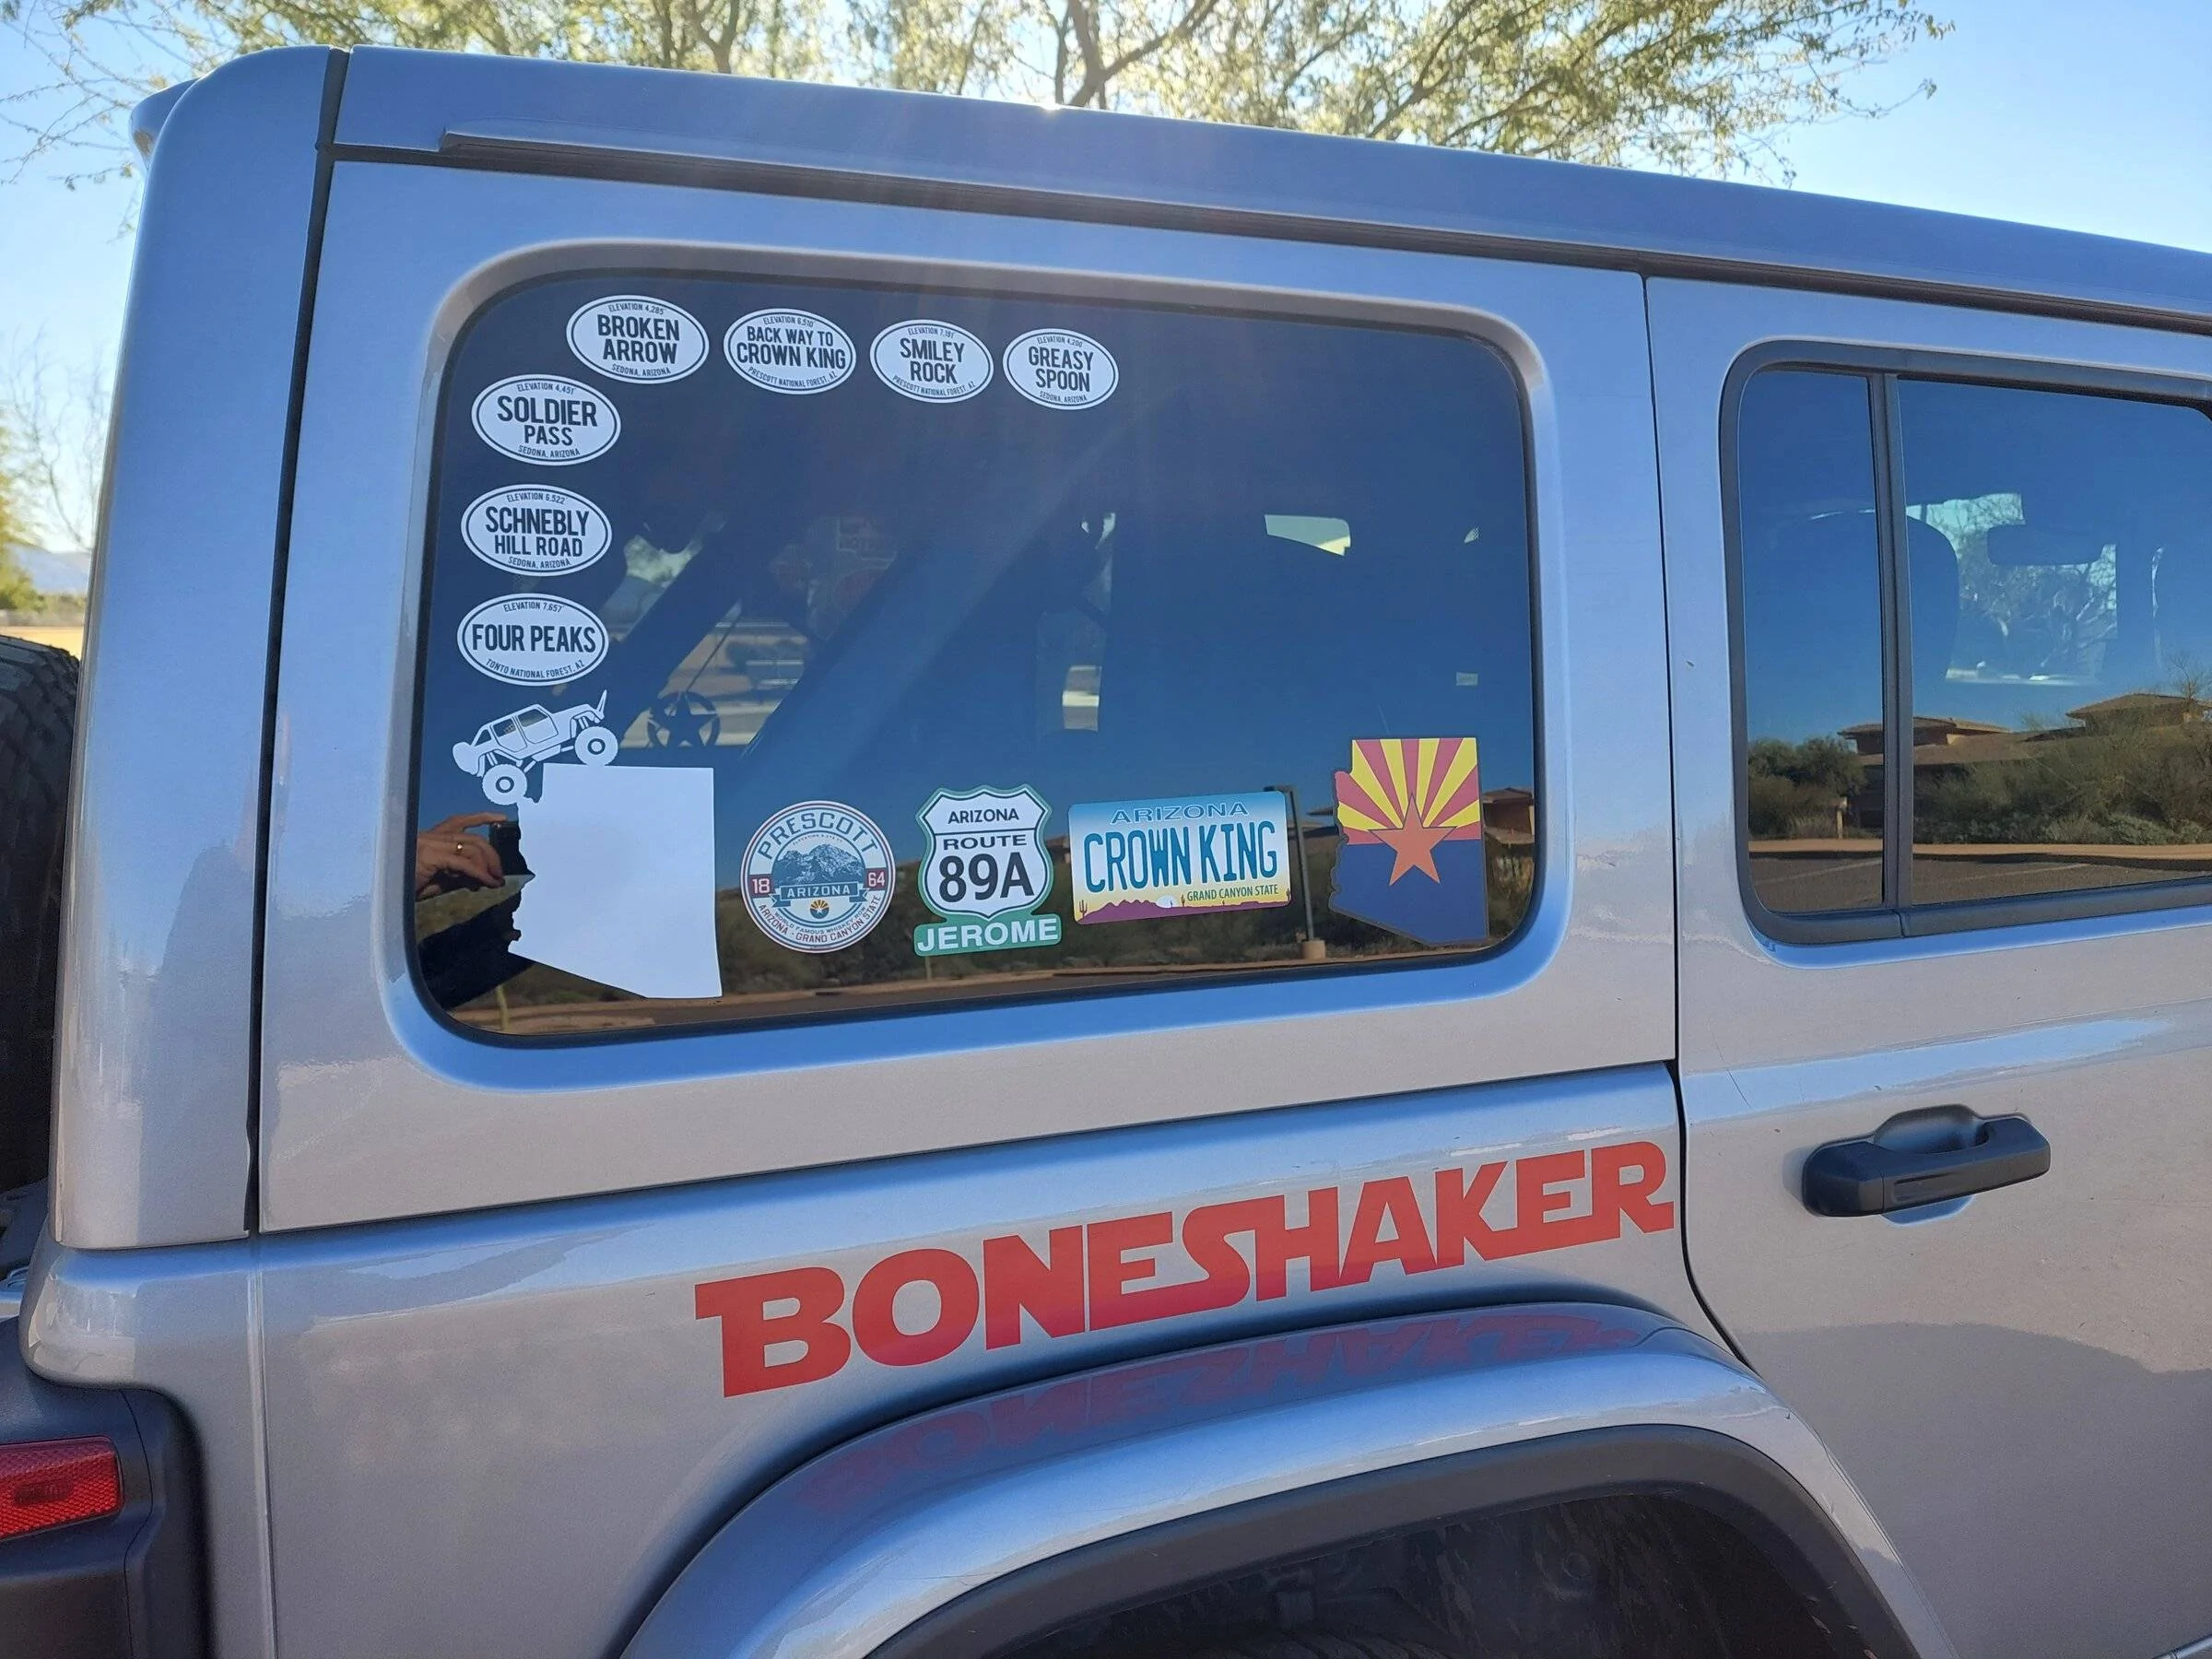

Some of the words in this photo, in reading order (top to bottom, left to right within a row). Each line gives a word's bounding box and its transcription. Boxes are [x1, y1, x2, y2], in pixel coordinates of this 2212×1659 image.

[608, 303, 643, 312] ELEVATION
[597, 314, 680, 341] BROKEN
[747, 326, 782, 343] BACK
[785, 328, 814, 345] WAY
[818, 332, 833, 347] TO
[900, 337, 964, 362] SMILEY
[1037, 335, 1065, 345] ELEVATION
[603, 339, 677, 364] ARROW
[737, 343, 801, 367] CROWN
[807, 347, 846, 369] KING
[1029, 347, 1093, 371] GREASY
[641, 367, 671, 376] ARIZONA
[748, 367, 778, 384] PRESCOTT
[779, 378, 806, 387] NATIONAL
[830, 371, 837, 380] AZ
[911, 361, 958, 383] ROCK
[1036, 369, 1089, 392] SPOON
[517, 382, 553, 393] ELEVATION
[892, 375, 920, 393] PRESCOTT
[920, 387, 946, 395] NATIONAL
[1064, 394, 1087, 404] ARIZONA
[498, 395, 597, 427] SOLDIER
[524, 424, 573, 446] PASS
[549, 448, 581, 458] ARIZONA
[507, 493, 544, 502] ELEVATION
[485, 507, 589, 536] SCHNEBLY
[494, 535, 531, 555] HILL
[536, 536, 582, 557] ROAD
[540, 559, 571, 569] ARIZONA
[503, 601, 540, 612] ELEVATION
[472, 624, 525, 651] FOUR
[531, 625, 595, 653] PEAKS
[486, 658, 509, 674] TONTO
[510, 667, 546, 678] NATIONAL
[575, 660, 584, 671] AZ
[947, 807, 1019, 824] ARIZONA
[1110, 802, 1249, 825] ARIZONA
[758, 813, 878, 859] PRESCOTT
[943, 834, 1028, 851] ROUTE
[1084, 827, 1191, 892] CROWN
[1199, 820, 1277, 885] KING
[752, 877, 771, 894] 18
[867, 872, 885, 887] 64
[938, 852, 1034, 903] 89A
[787, 885, 850, 898] ARIZONA
[1187, 888, 1218, 902] GRAND
[1218, 887, 1253, 900] CANYON
[1254, 885, 1279, 898] STATE
[759, 904, 788, 935] ARIZONA
[795, 932, 828, 944] GRAND
[830, 918, 865, 941] CANYON
[863, 896, 881, 919] STATE
[918, 918, 1058, 951] JEROME
[695, 1141, 1674, 1397] BONESHAKER
